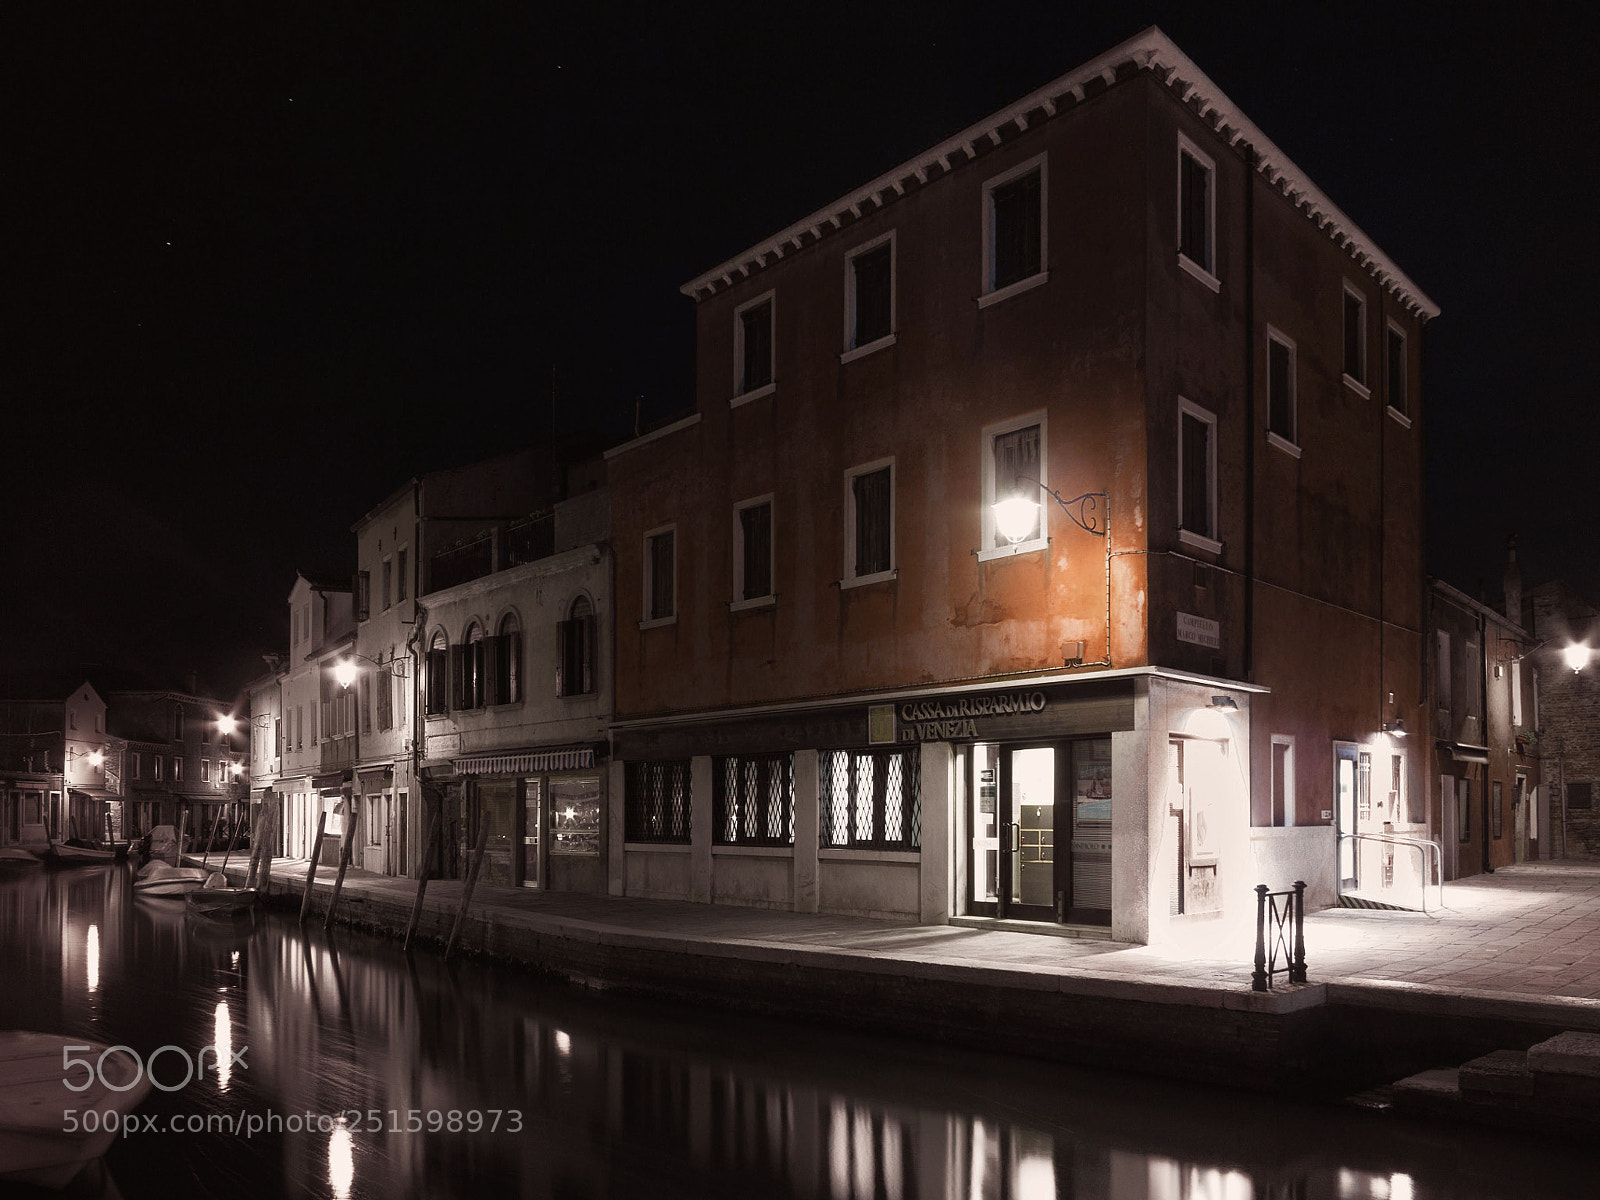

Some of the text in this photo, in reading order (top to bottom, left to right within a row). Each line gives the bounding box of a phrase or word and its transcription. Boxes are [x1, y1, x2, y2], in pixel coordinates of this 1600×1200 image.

[901, 702, 945, 721] CASSA
[960, 692, 1046, 716] RISPARMIO
[915, 718, 979, 740] VENEZIA
